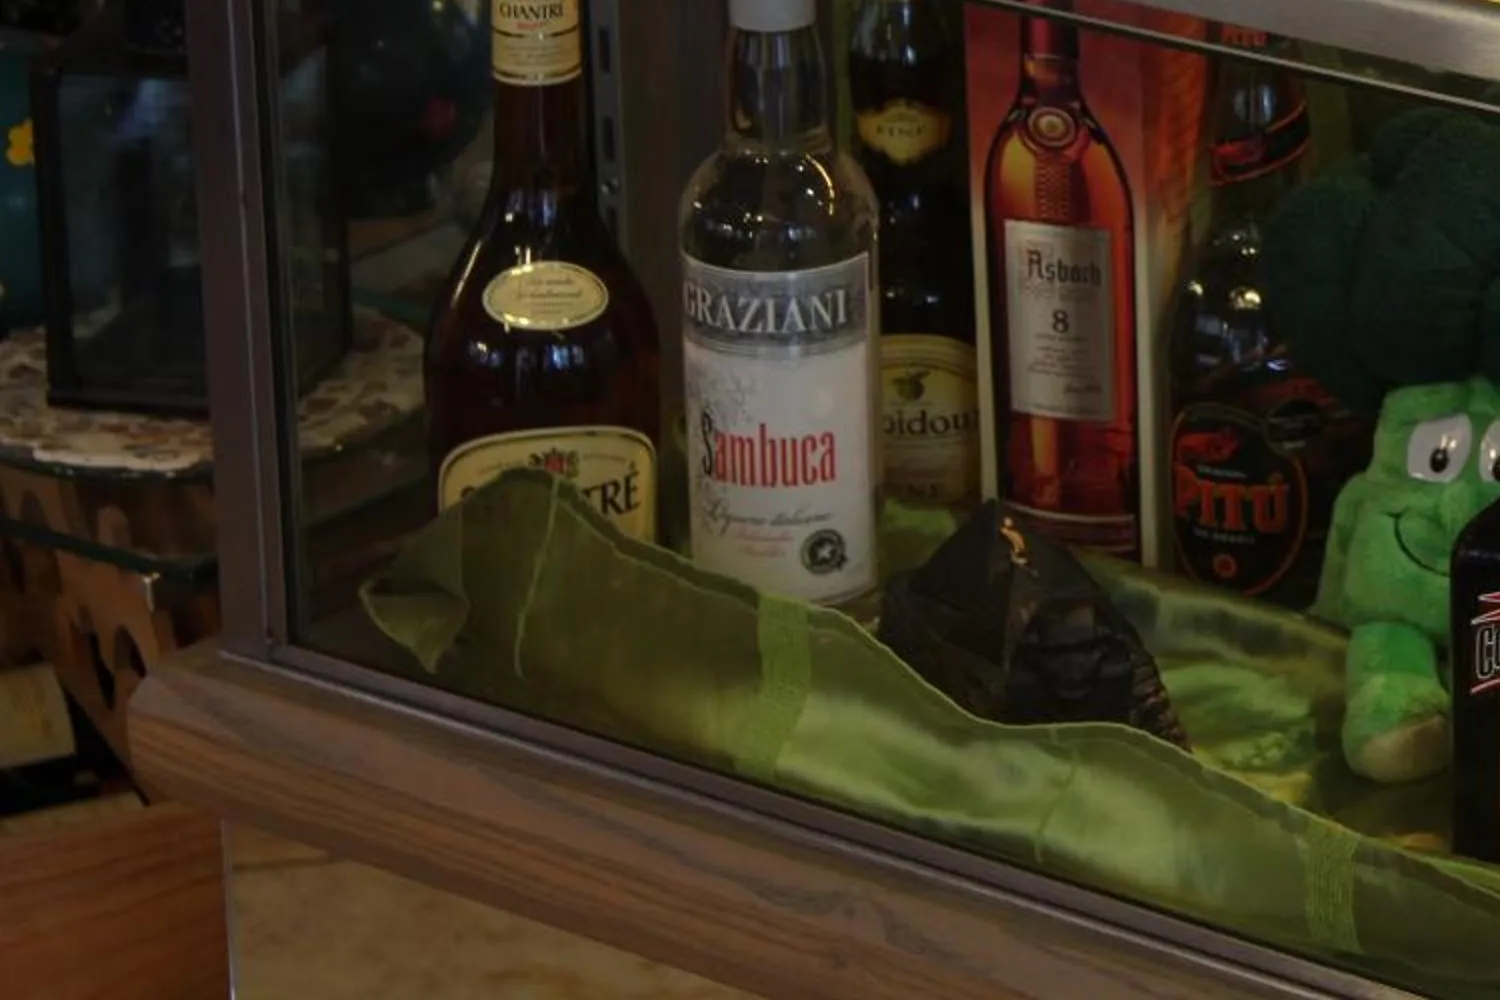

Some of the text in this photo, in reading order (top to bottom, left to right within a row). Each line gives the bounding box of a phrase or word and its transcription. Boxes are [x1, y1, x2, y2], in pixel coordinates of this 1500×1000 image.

[1027, 250, 1102, 286] Asbach
[683, 280, 848, 334] GRAZIANI
[1052, 309, 1069, 334] 8
[701, 411, 836, 488] Sambuca
[1172, 463, 1290, 534] PITÚ
